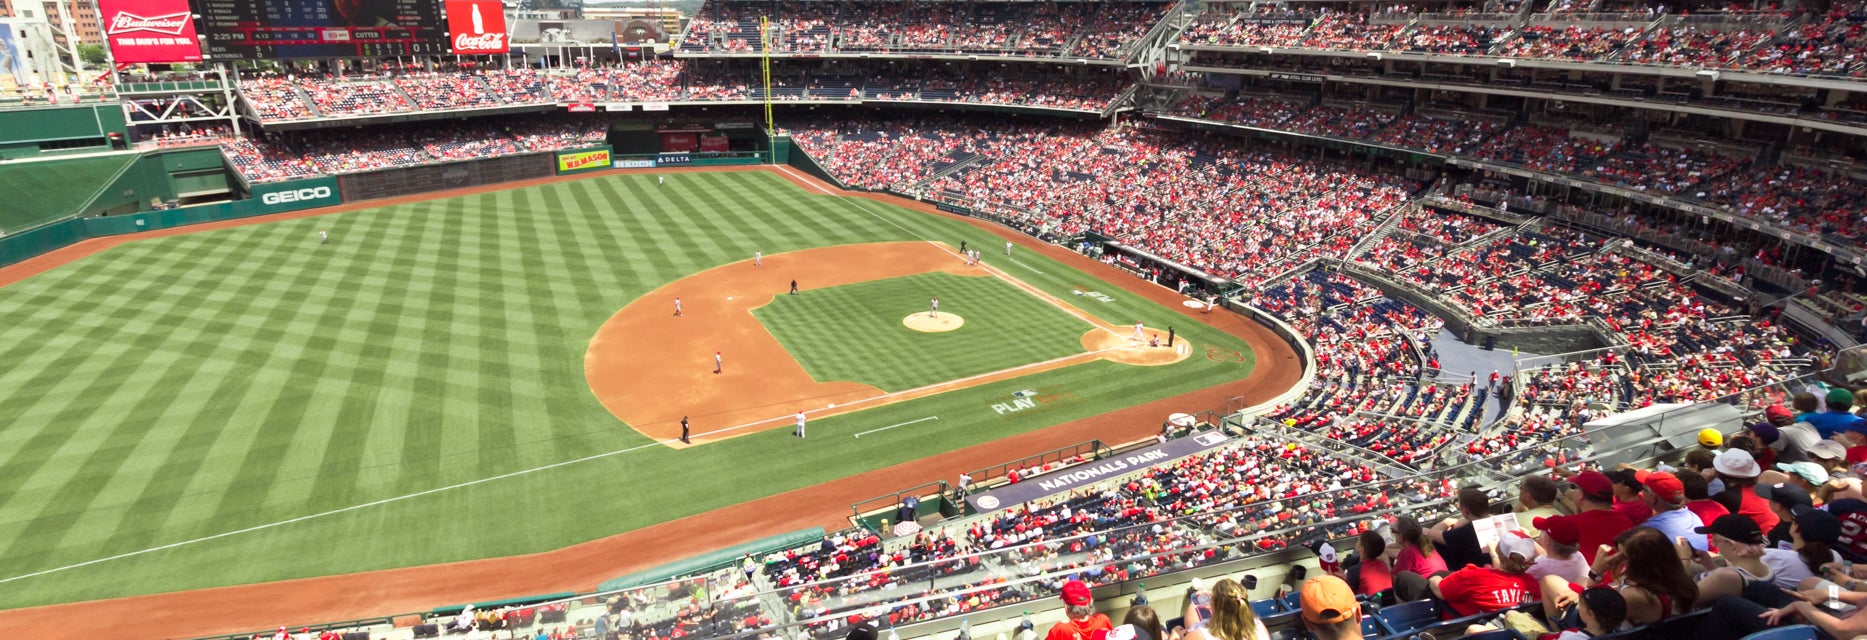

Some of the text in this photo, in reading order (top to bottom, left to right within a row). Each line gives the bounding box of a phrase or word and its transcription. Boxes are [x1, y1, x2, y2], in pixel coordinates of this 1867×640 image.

[112, 16, 184, 28] Budweiser
[116, 38, 135, 46] THIS
[412, 43, 420, 52] 0
[455, 33, 504, 50] Coca-Cola
[262, 186, 331, 205] GEICO
[991, 397, 1036, 414] PLAY
[1039, 449, 1169, 490] NATIONALS PARK
